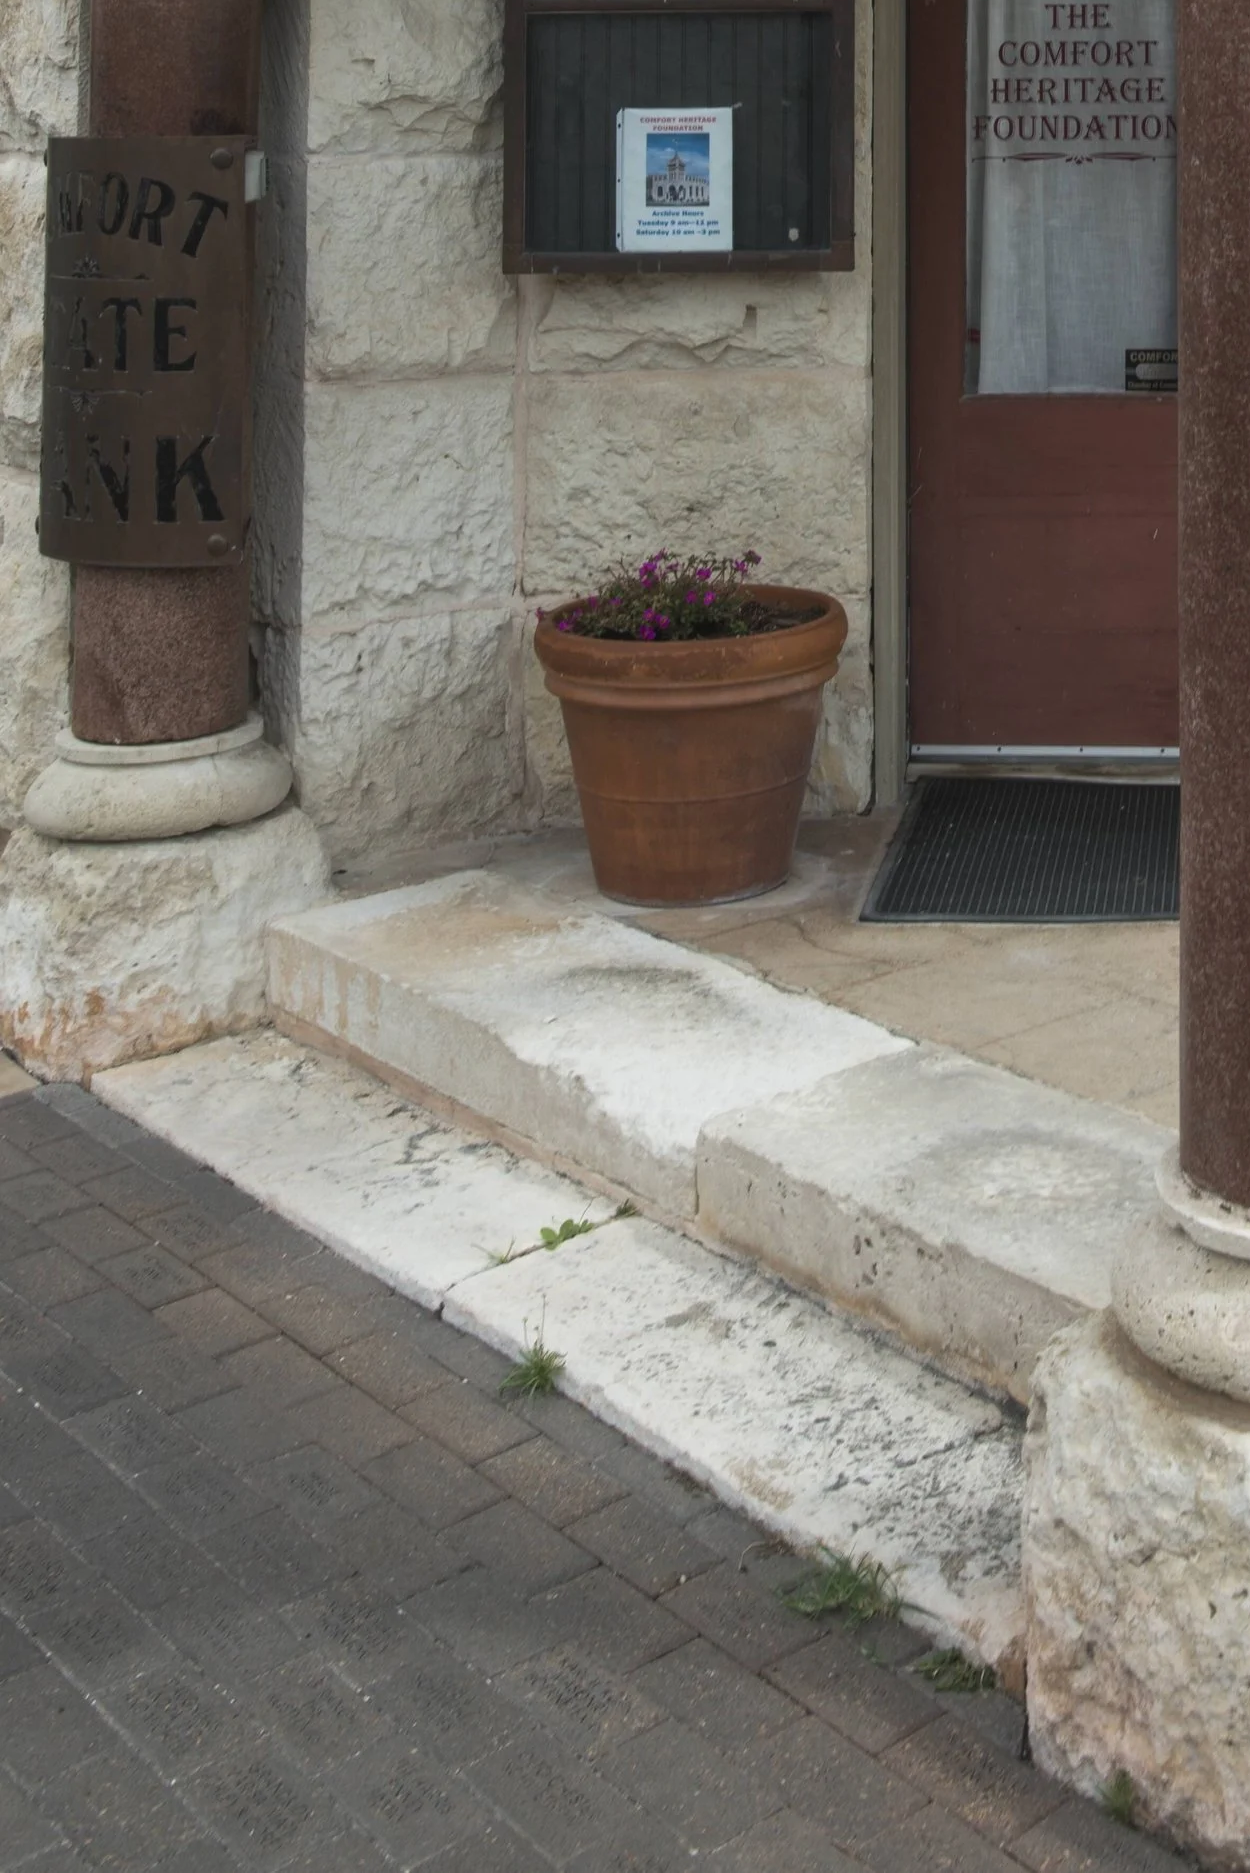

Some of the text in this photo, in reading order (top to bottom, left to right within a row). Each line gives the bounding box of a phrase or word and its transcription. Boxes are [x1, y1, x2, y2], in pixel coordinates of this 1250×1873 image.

[1045, 3, 1112, 30] THE
[998, 40, 1159, 68] COMFORT
[991, 77, 1166, 106] HERITAGE
[639, 116, 717, 124] COMFORT HERITAGE
